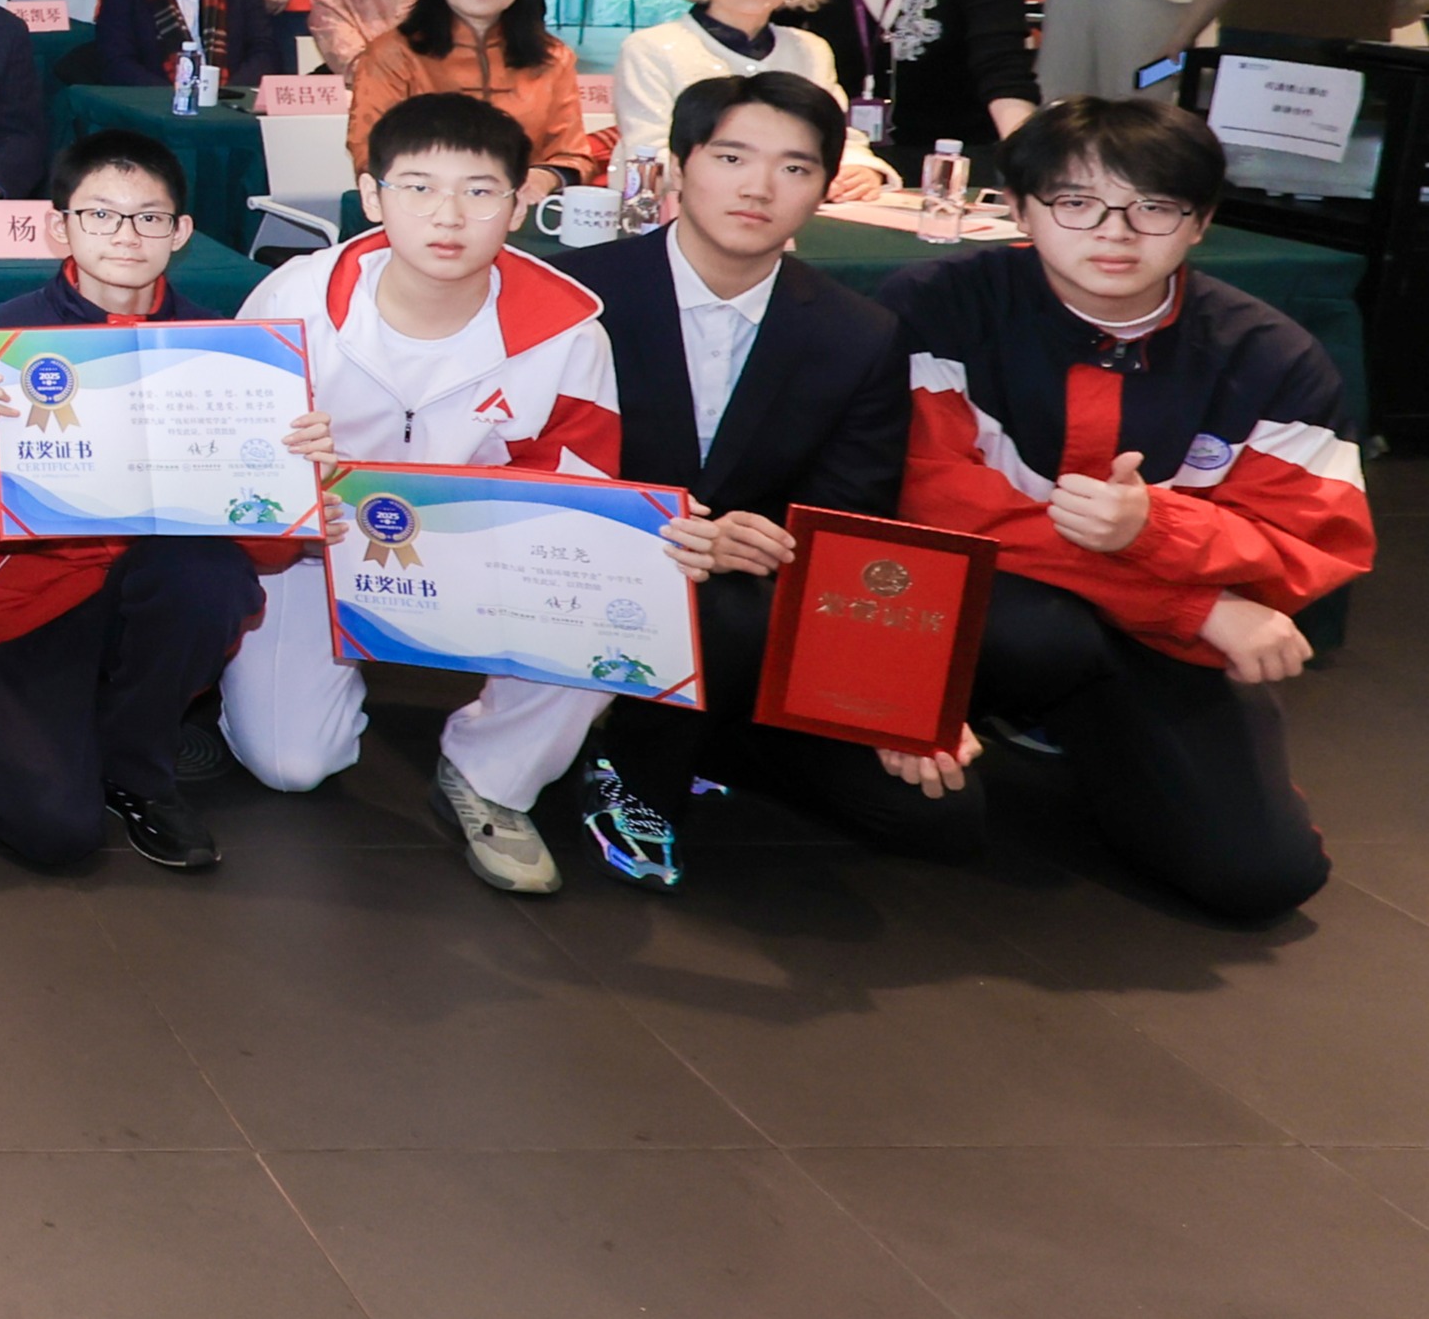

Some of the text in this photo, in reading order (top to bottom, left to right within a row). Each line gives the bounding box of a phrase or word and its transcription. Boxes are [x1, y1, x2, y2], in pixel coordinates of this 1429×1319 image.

[8, 215, 36, 243] 杨
[17, 440, 93, 460] 获奖证书
[17, 461, 95, 473] CERTIFICATE
[354, 573, 437, 598] 获奖证书
[354, 594, 441, 611] CERTIFICATE
